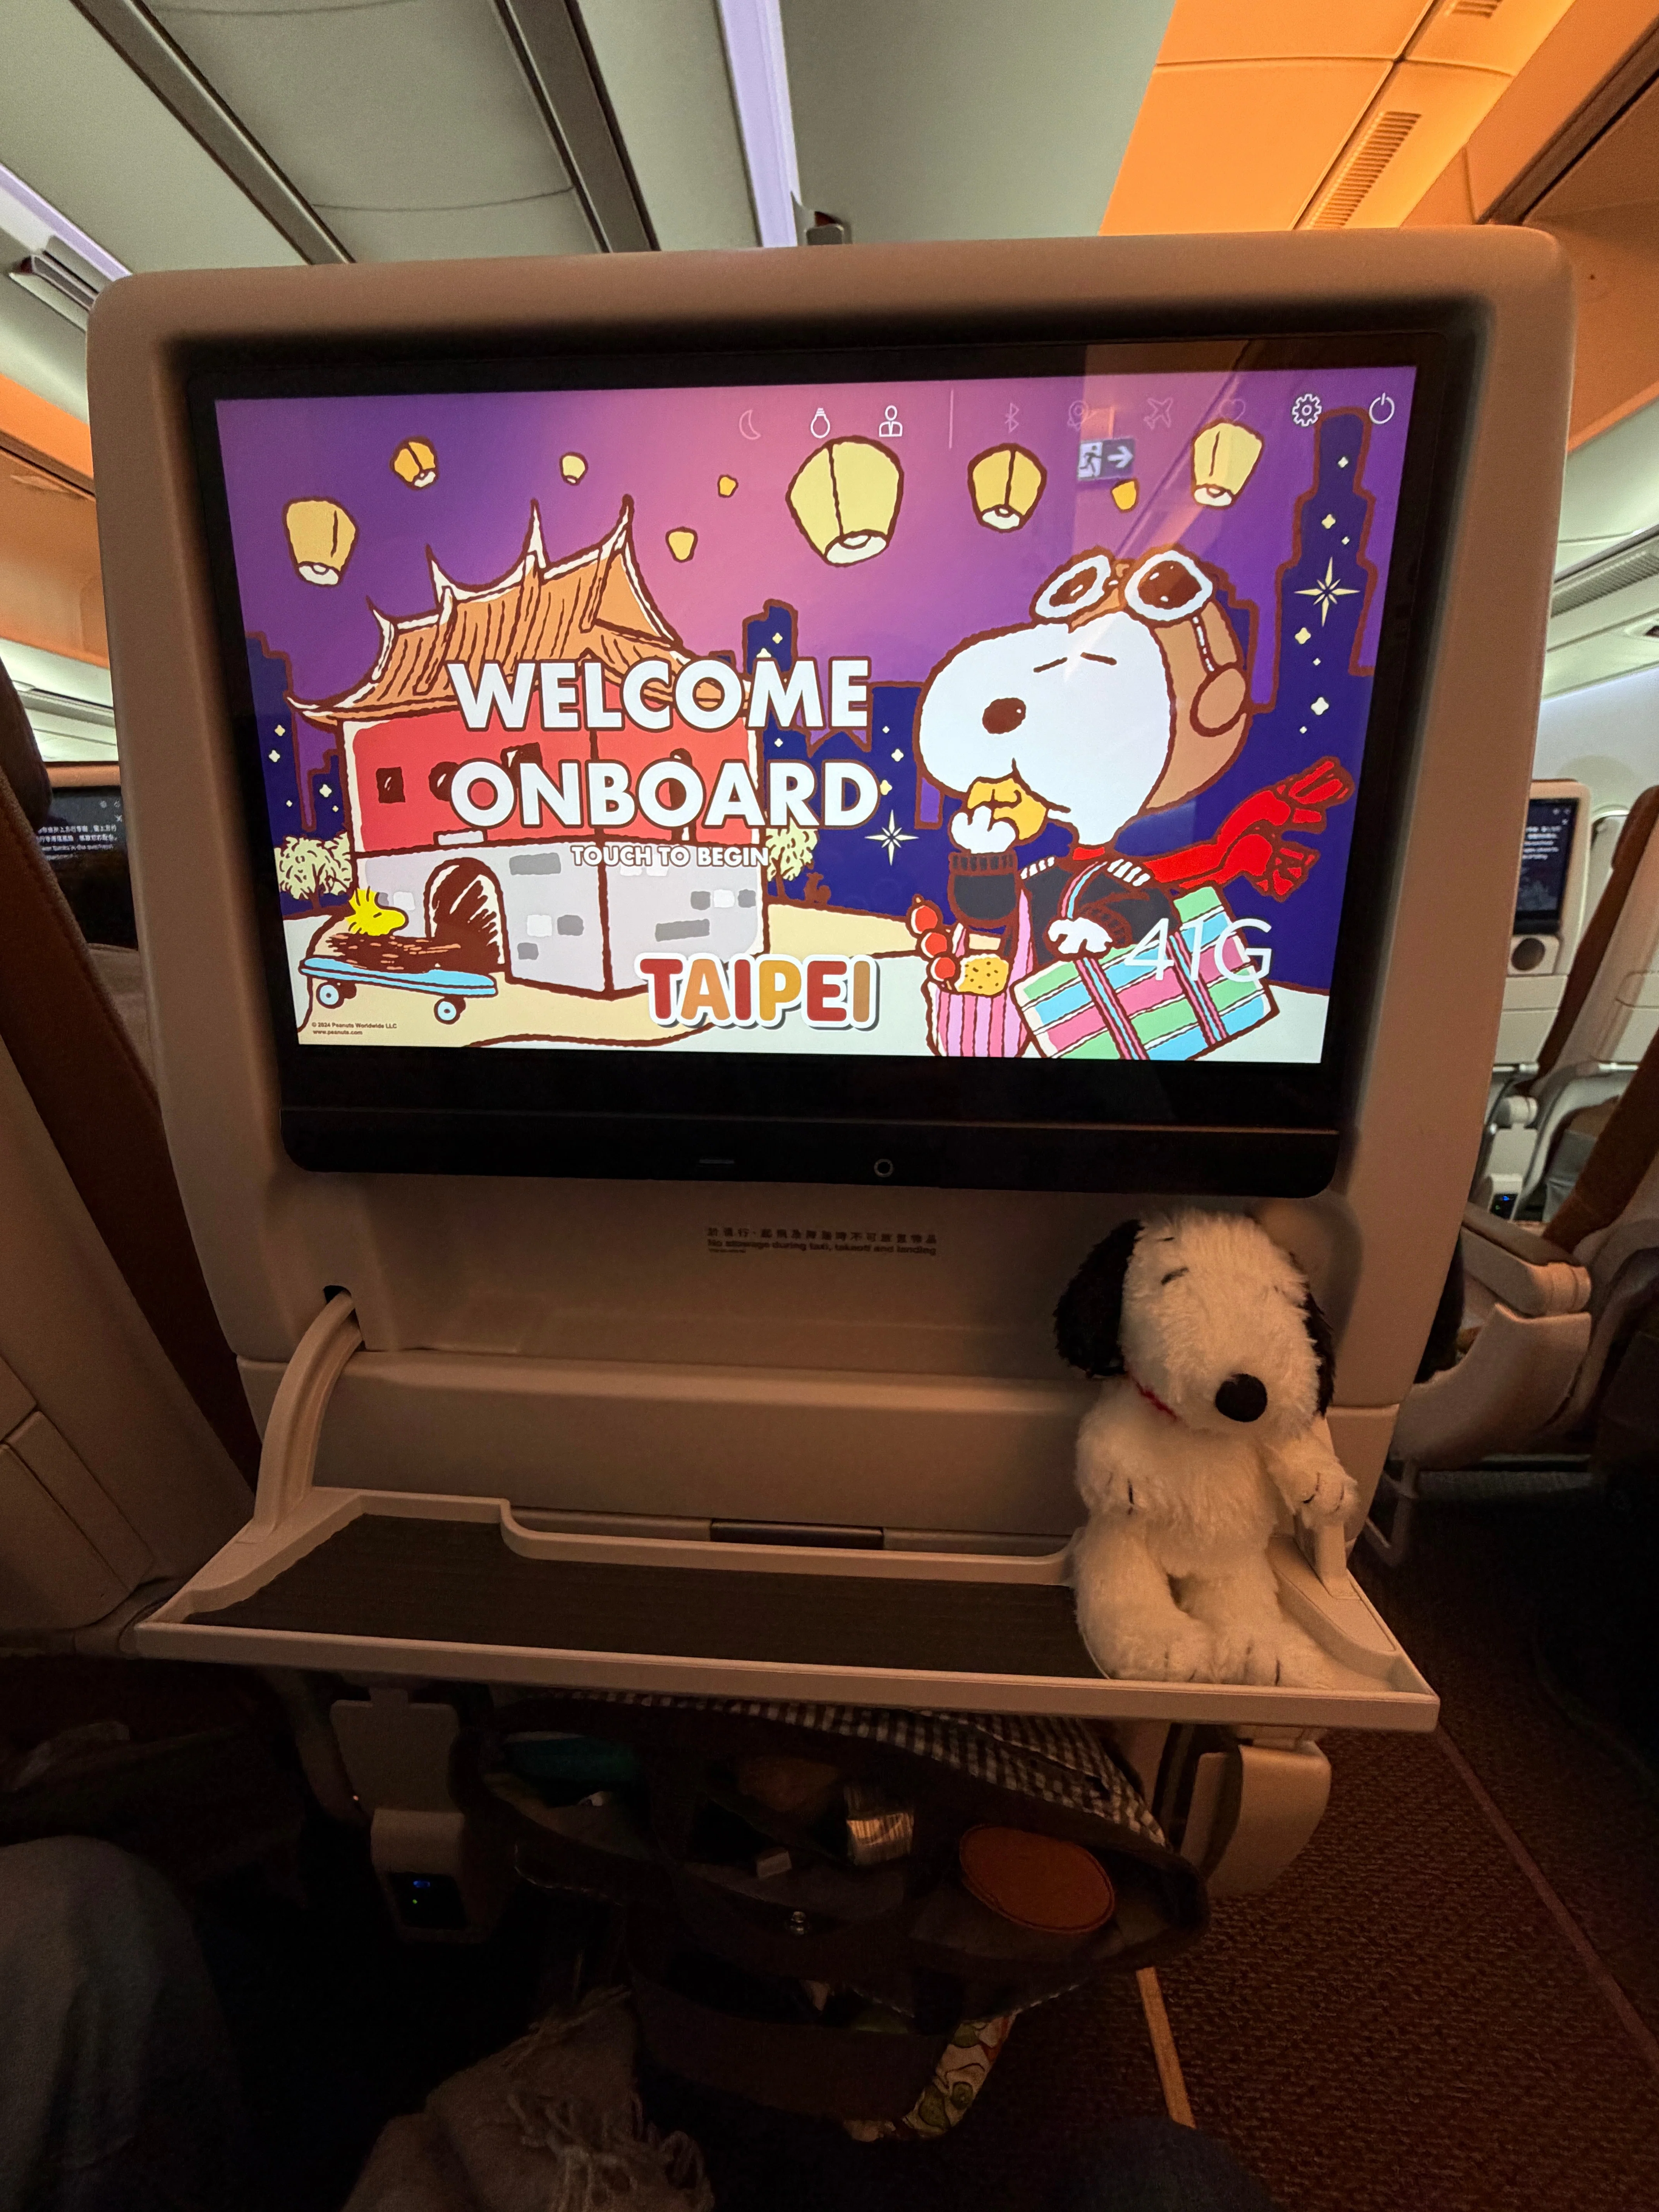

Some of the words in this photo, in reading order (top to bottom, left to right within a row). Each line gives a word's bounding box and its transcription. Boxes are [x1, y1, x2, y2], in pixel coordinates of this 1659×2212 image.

[448, 656, 871, 733] WELCOME
[449, 759, 880, 829] ONBOARD
[573, 845, 651, 867] TOUCH
[657, 845, 689, 867] TO
[696, 845, 770, 867] BEGIN
[1124, 918, 1272, 982] 41G
[637, 953, 879, 1029] TAIPEI
[772, 1241, 807, 1251] during
[896, 1245, 936, 1255] landing
